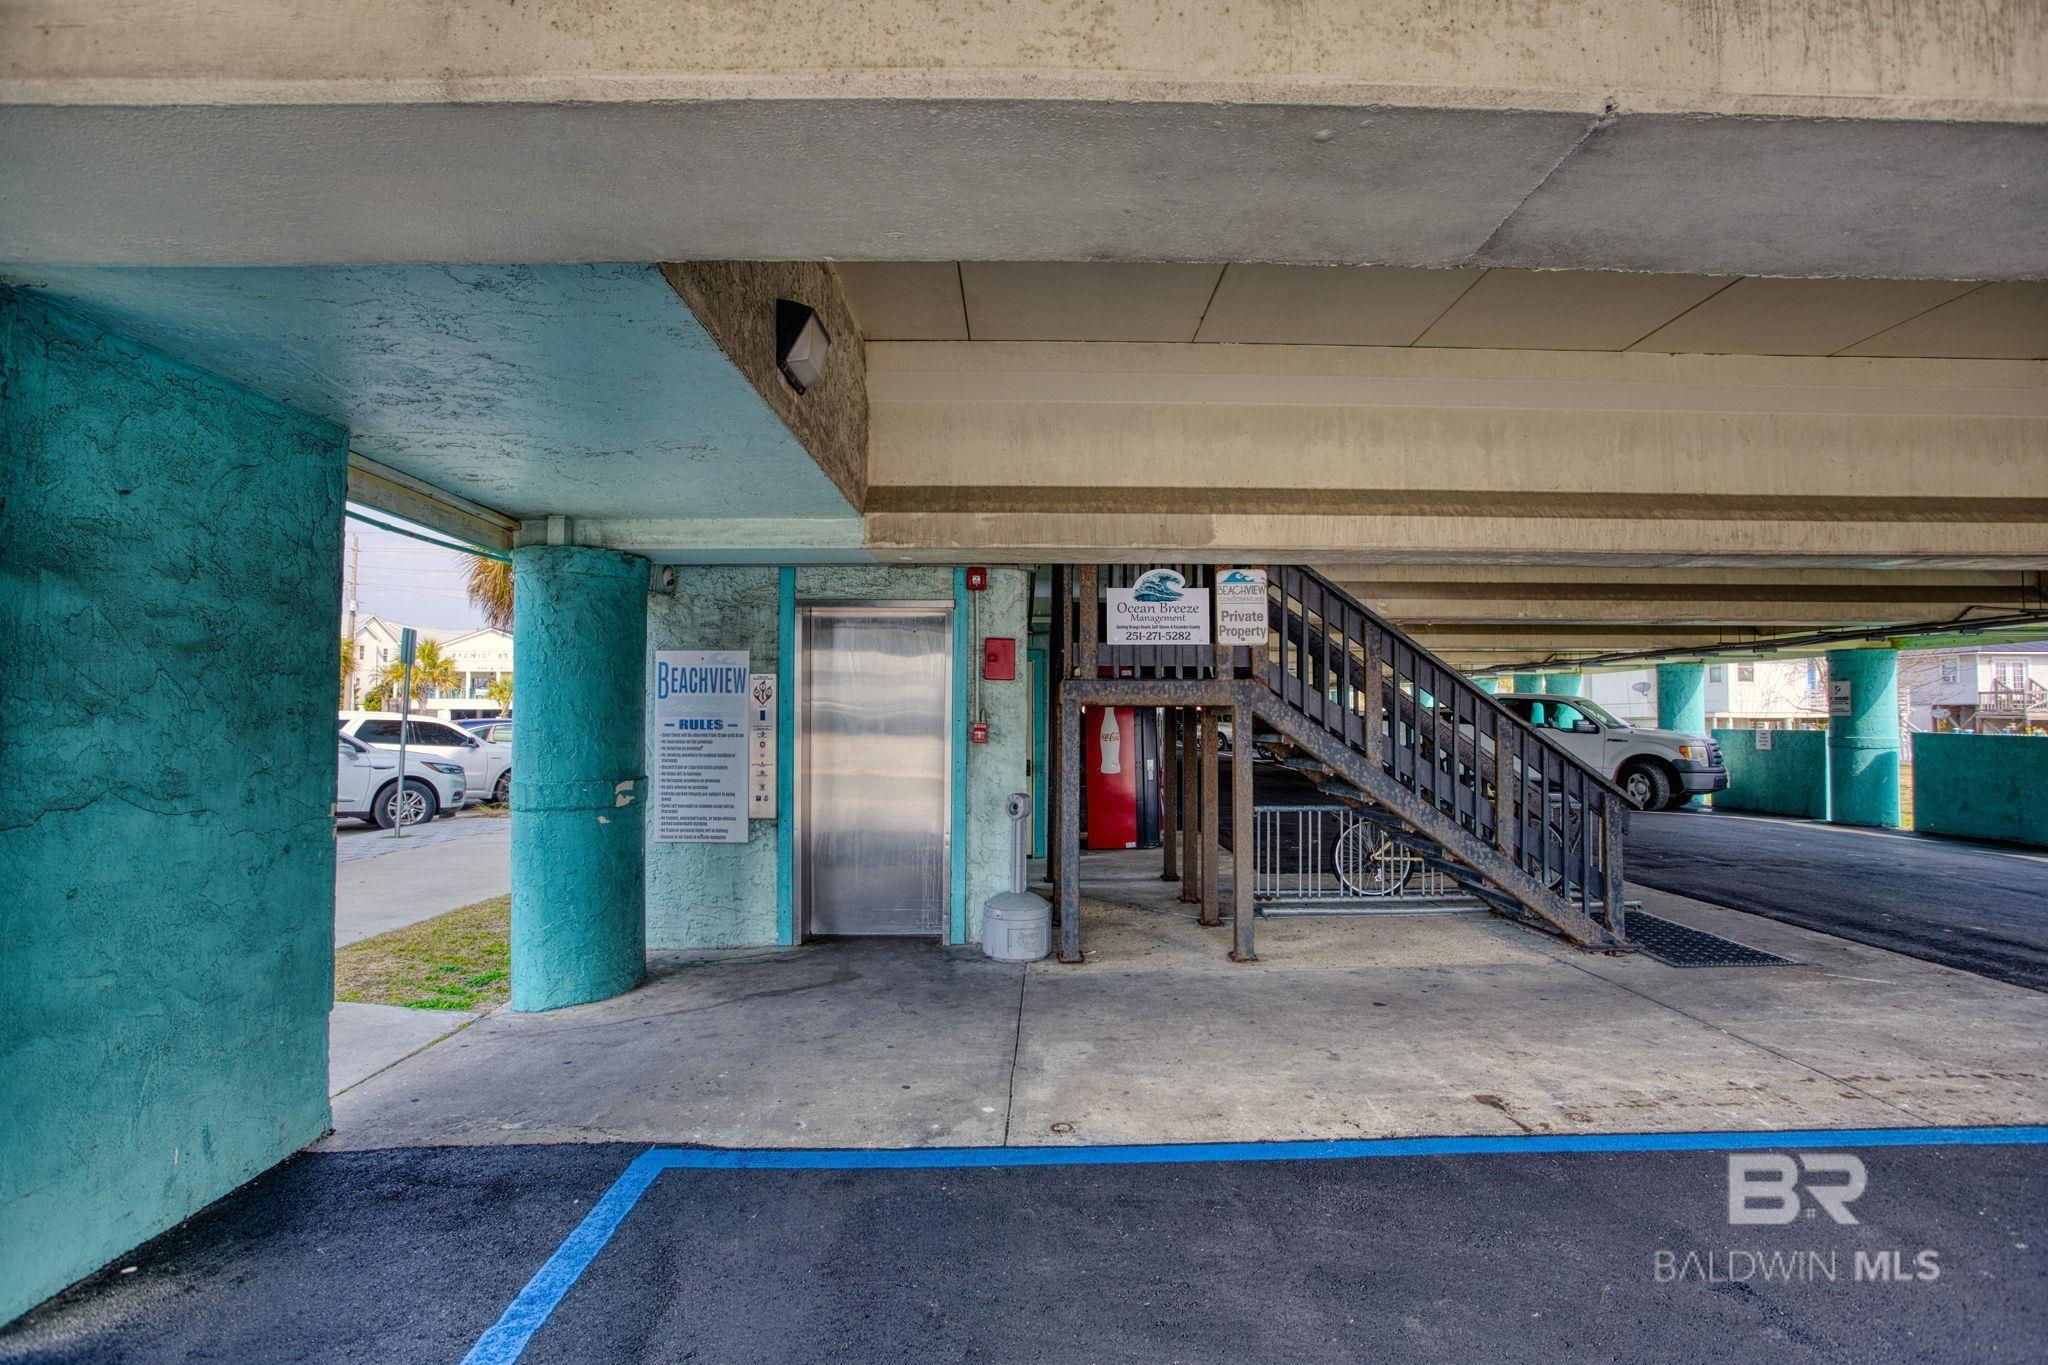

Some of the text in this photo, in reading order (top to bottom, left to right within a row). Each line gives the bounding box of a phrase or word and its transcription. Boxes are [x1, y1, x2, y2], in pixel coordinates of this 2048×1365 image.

[1217, 585, 1265, 595] BEACHVIEW
[1117, 602, 1199, 613] Ocean Breeze
[1130, 614, 1186, 624] Management
[1221, 610, 1264, 622] Private
[1126, 631, 1191, 641] 251-271-5282
[1219, 625, 1267, 638] Property
[658, 661, 746, 699] BEACHVIEW
[678, 719, 723, 730] RULES
